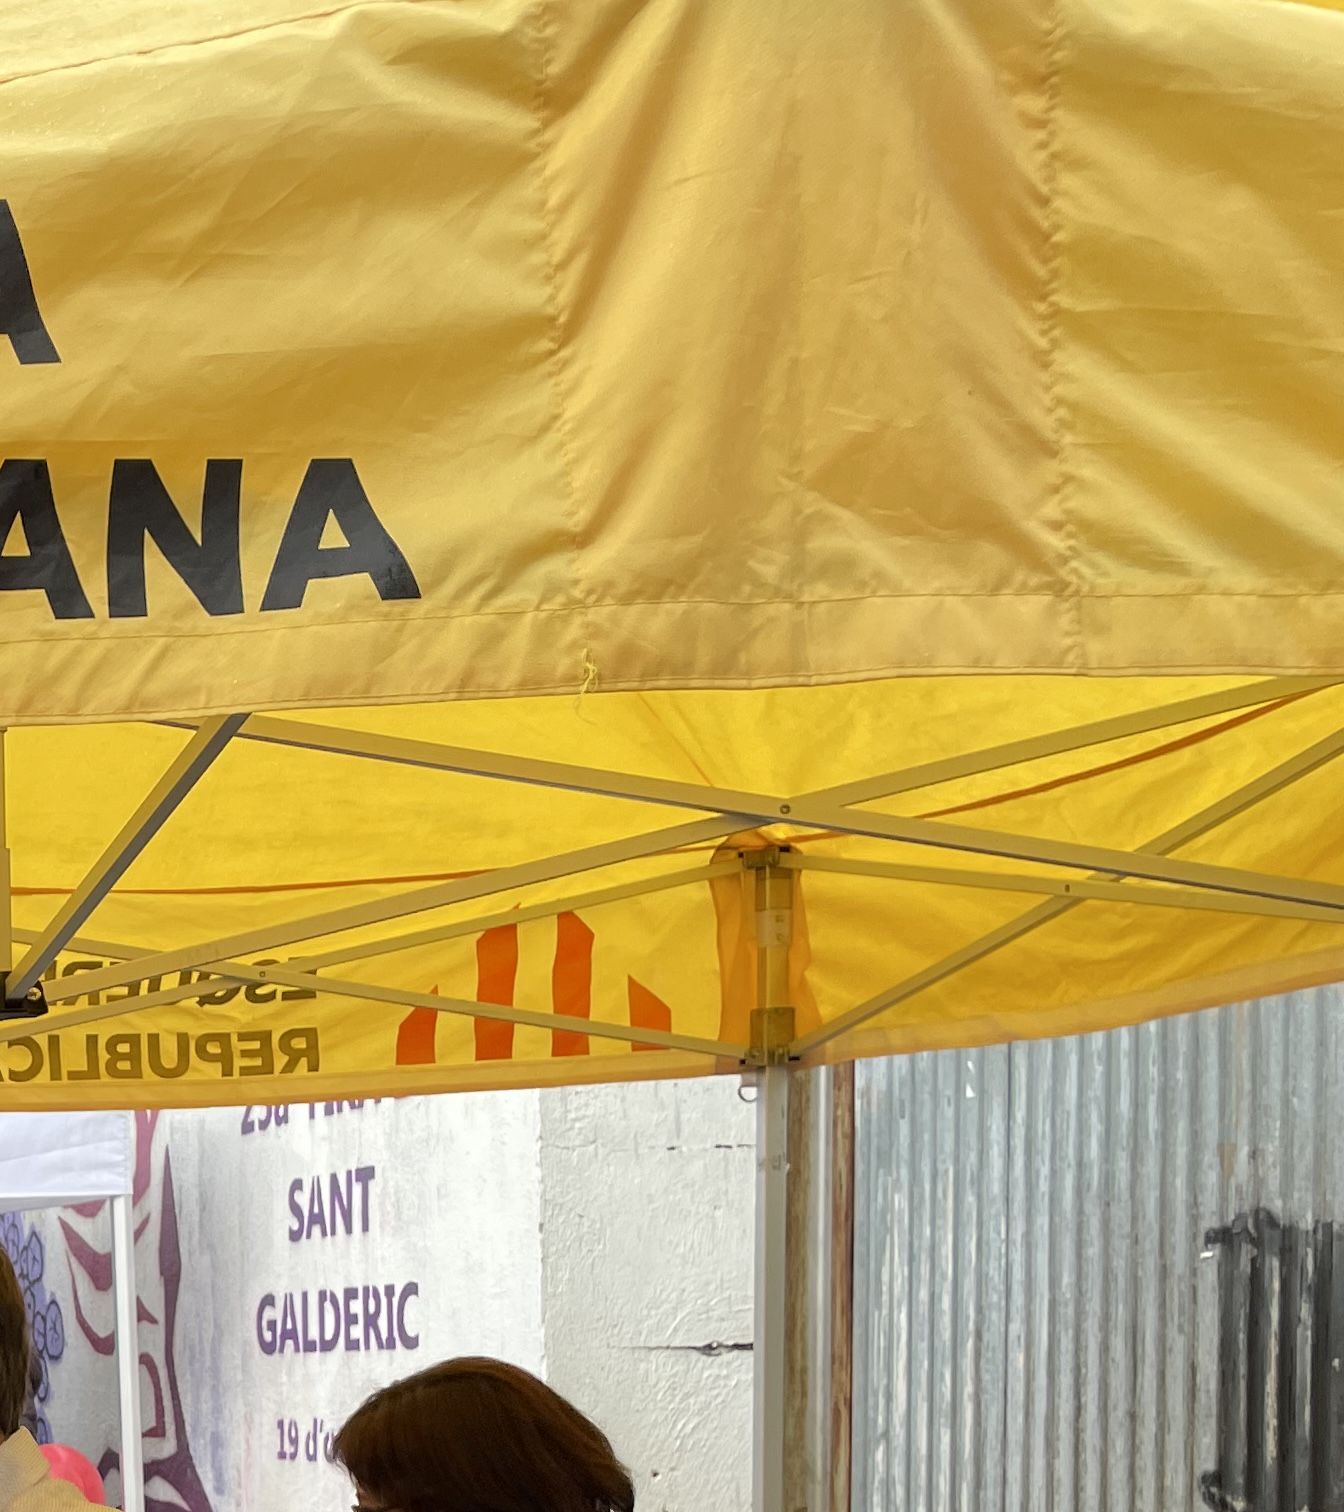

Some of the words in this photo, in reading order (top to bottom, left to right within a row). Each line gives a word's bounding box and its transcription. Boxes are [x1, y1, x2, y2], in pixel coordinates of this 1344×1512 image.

[287, 1166, 376, 1242] SANT
[256, 1282, 420, 1356] GALDERIC
[276, 1418, 299, 1461] 19
